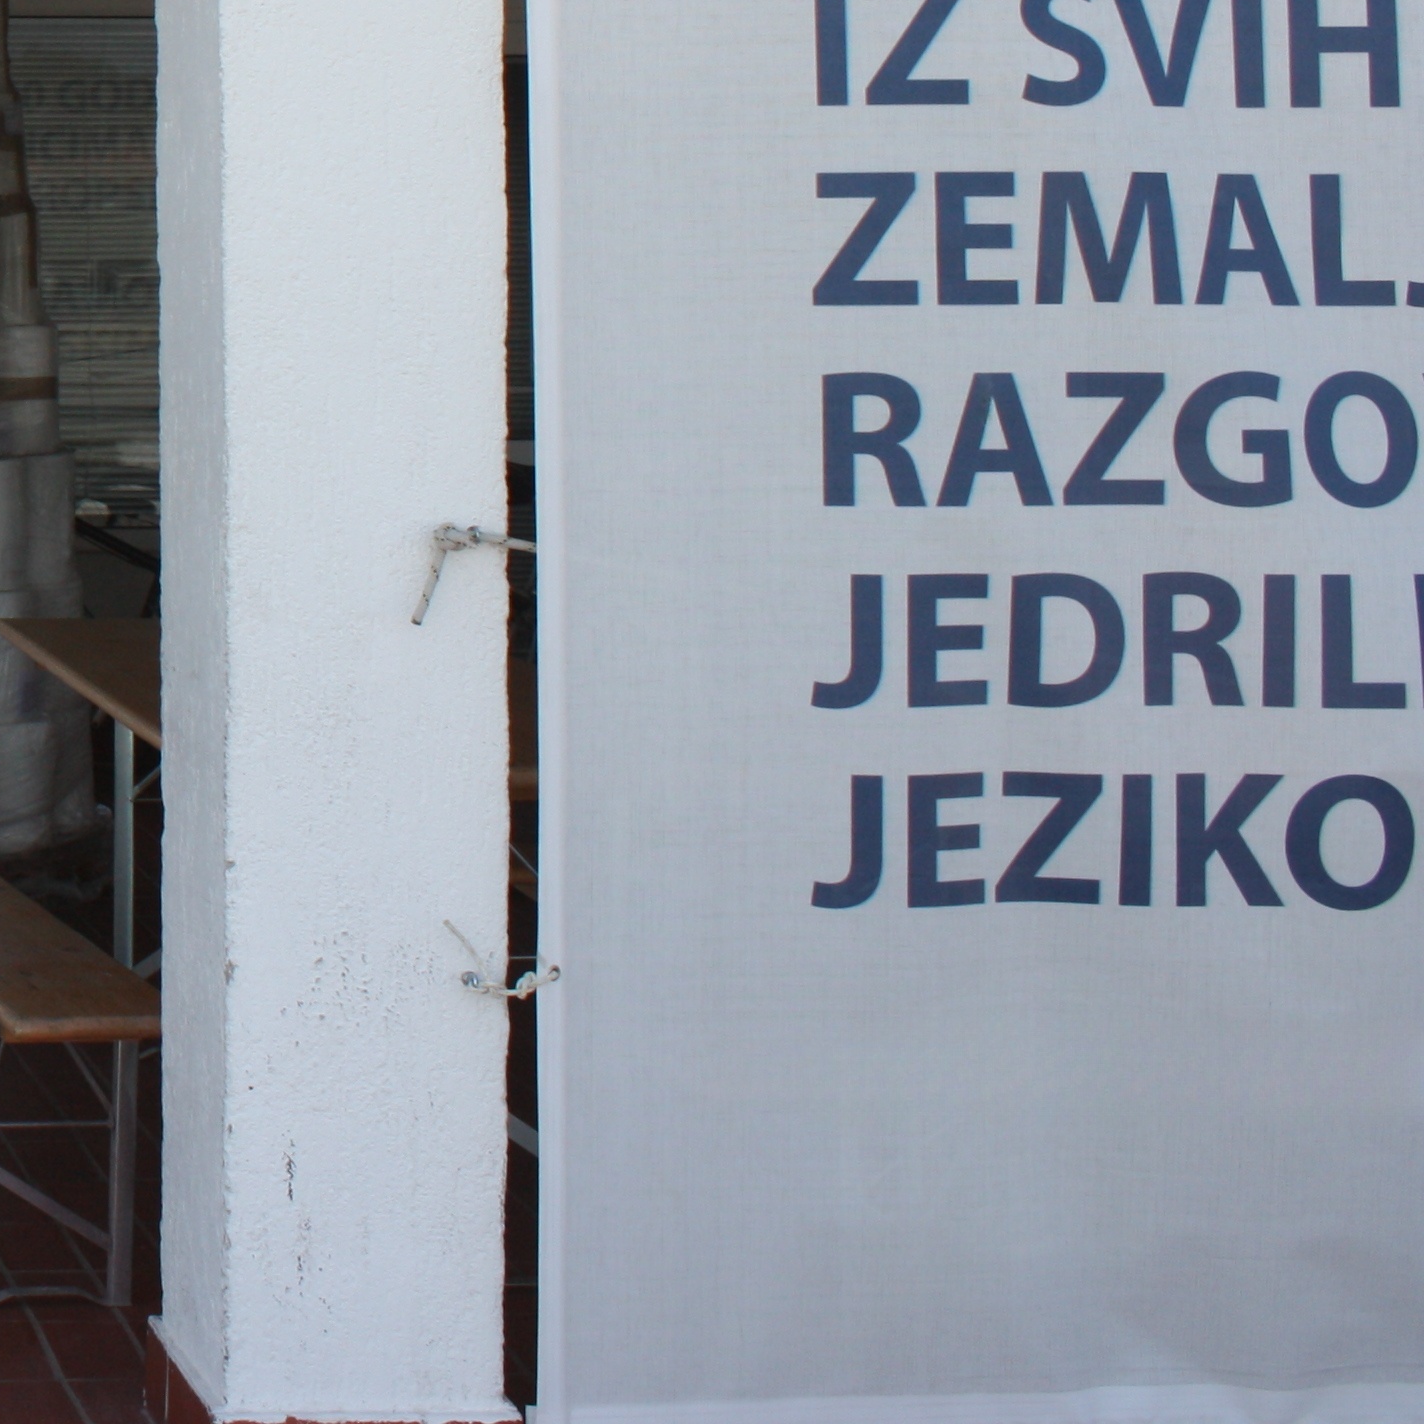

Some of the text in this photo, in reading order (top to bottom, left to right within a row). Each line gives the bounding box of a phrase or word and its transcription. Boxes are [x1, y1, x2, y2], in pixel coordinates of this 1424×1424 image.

[811, 170, 1424, 308] ZEMAL
[810, 570, 1424, 710] JEDRIL
[810, 770, 1417, 912] JEZIKO
